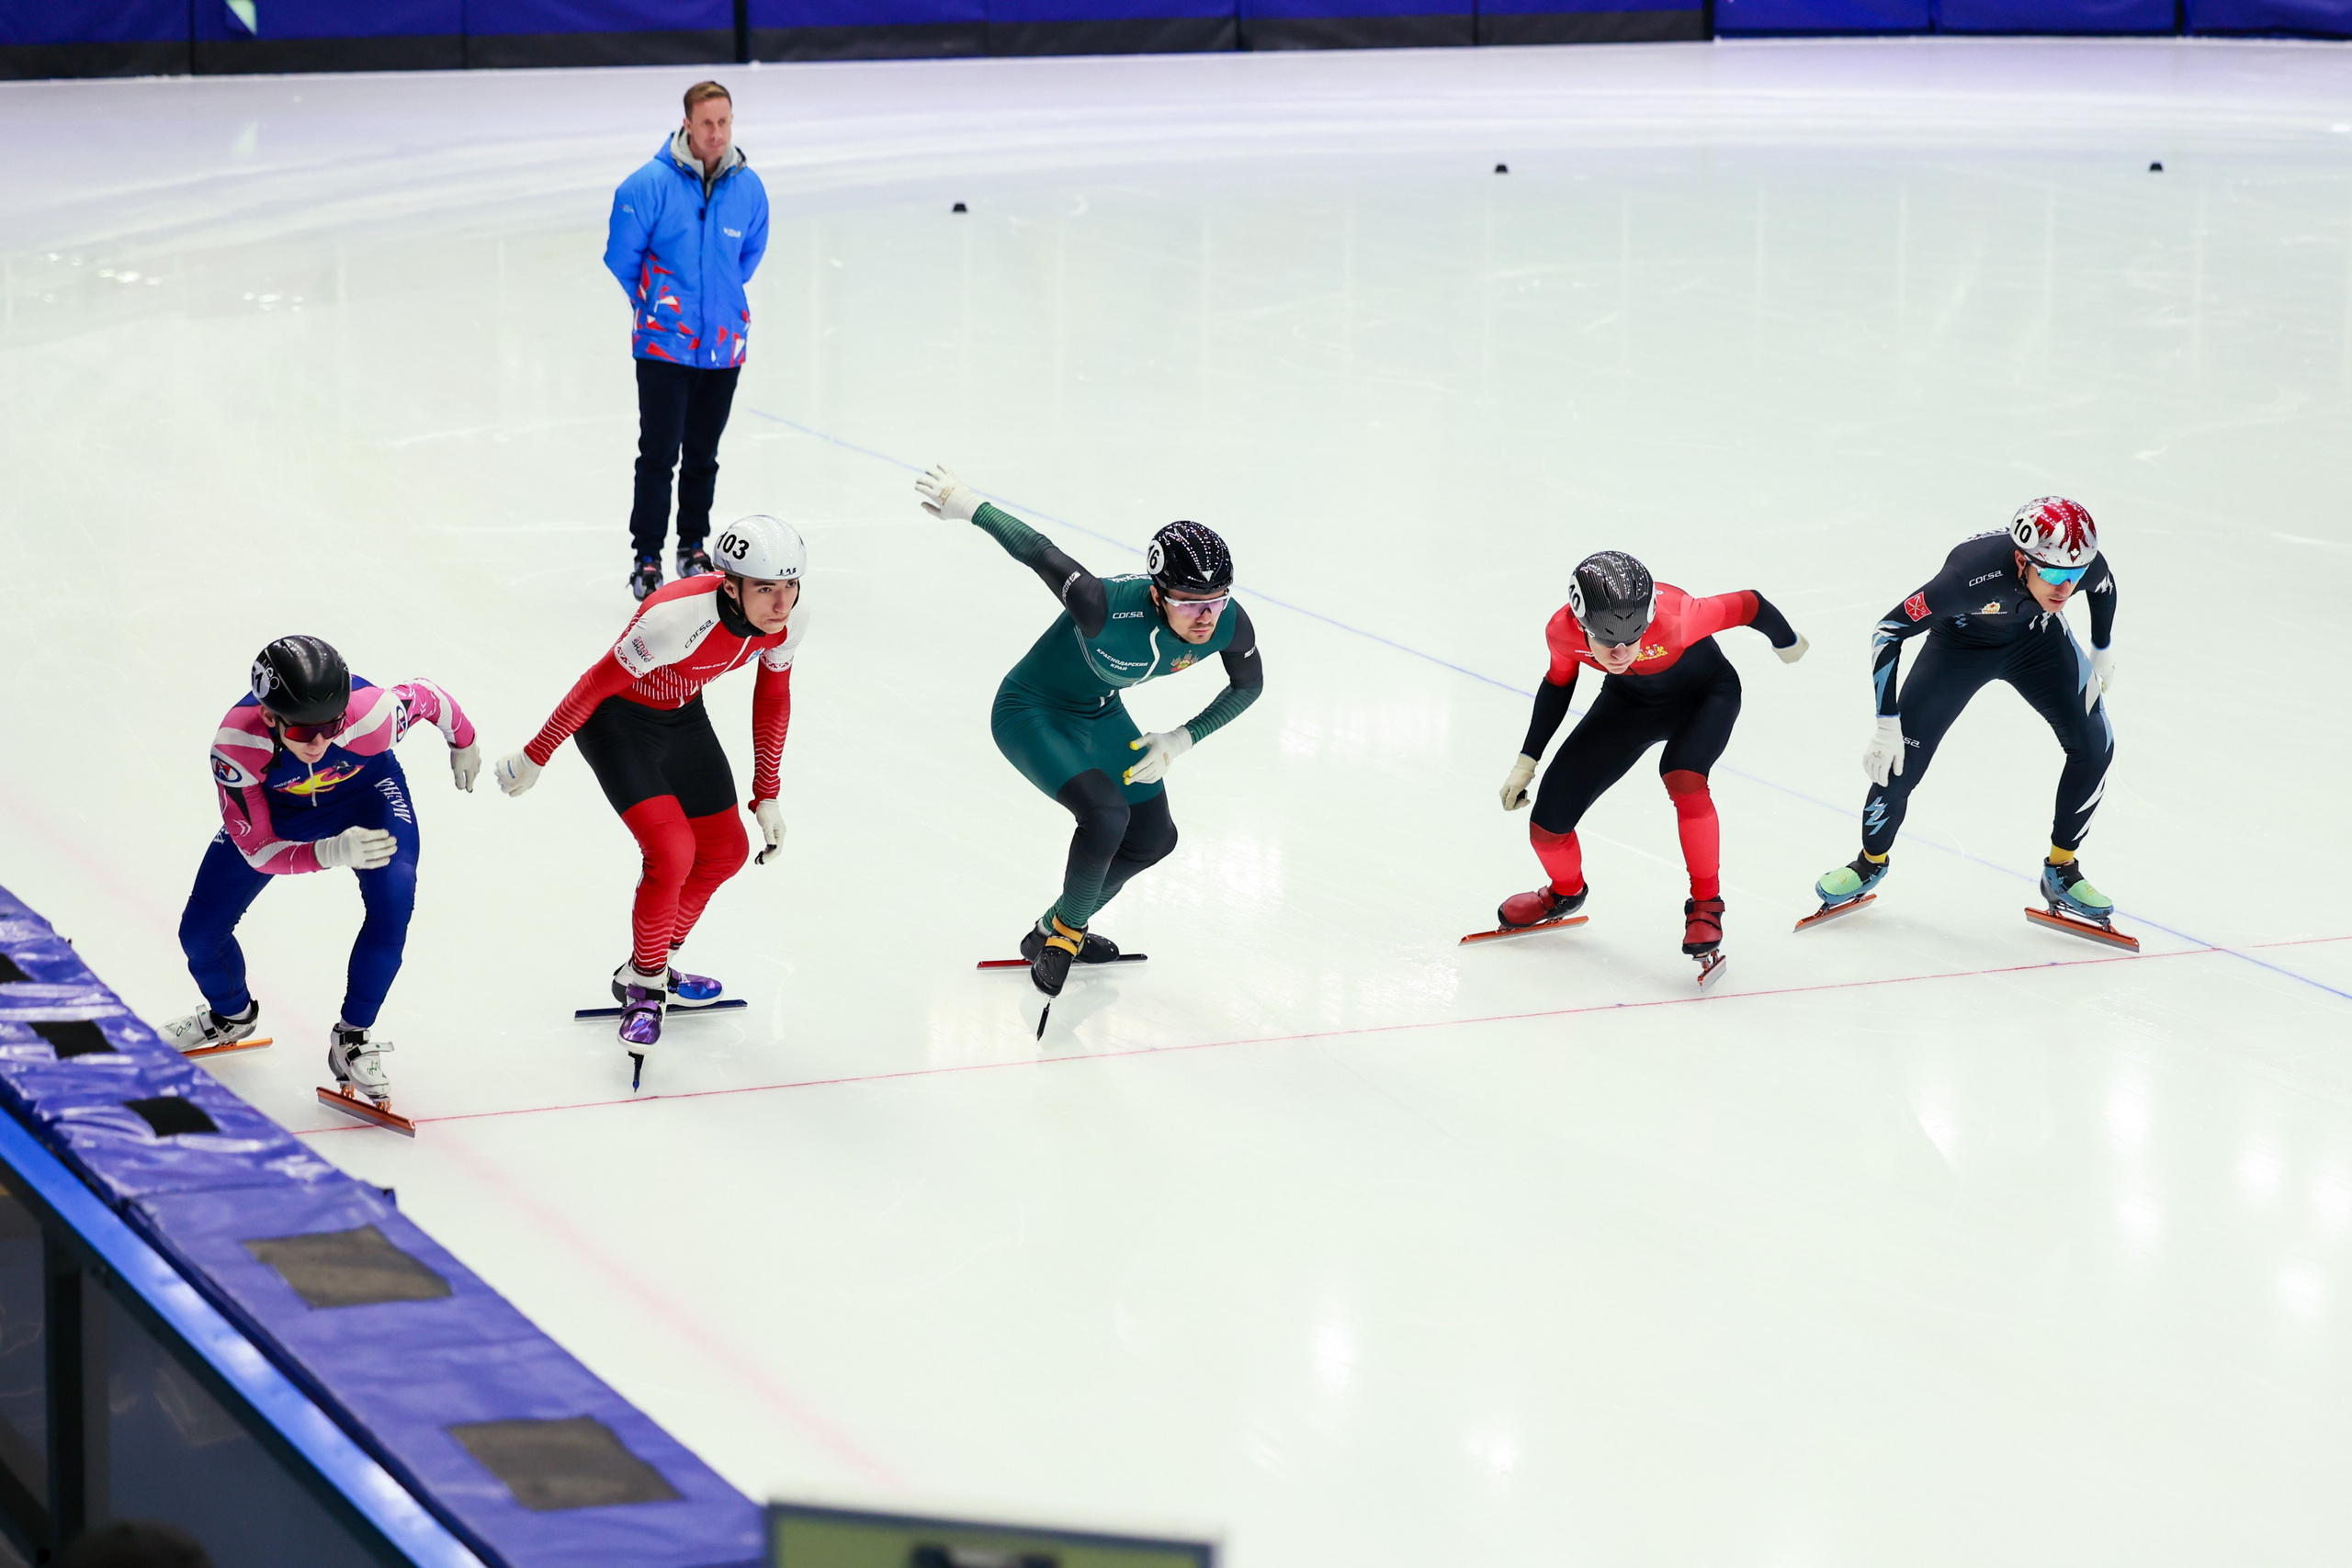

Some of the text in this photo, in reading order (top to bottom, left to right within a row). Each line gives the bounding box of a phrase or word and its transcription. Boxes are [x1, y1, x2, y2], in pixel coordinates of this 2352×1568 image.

[2014, 518, 2032, 544] 10
[717, 531, 750, 560] 103
[1969, 570, 2004, 587] corsa
[1112, 611, 1145, 620] corsa
[684, 619, 715, 649] corsa
[631, 638, 650, 662] skate
[636, 636, 655, 660] smart
[1096, 648, 1148, 667] КРАСНОДАРСКИЙ
[273, 775, 301, 788] МОСКВА
